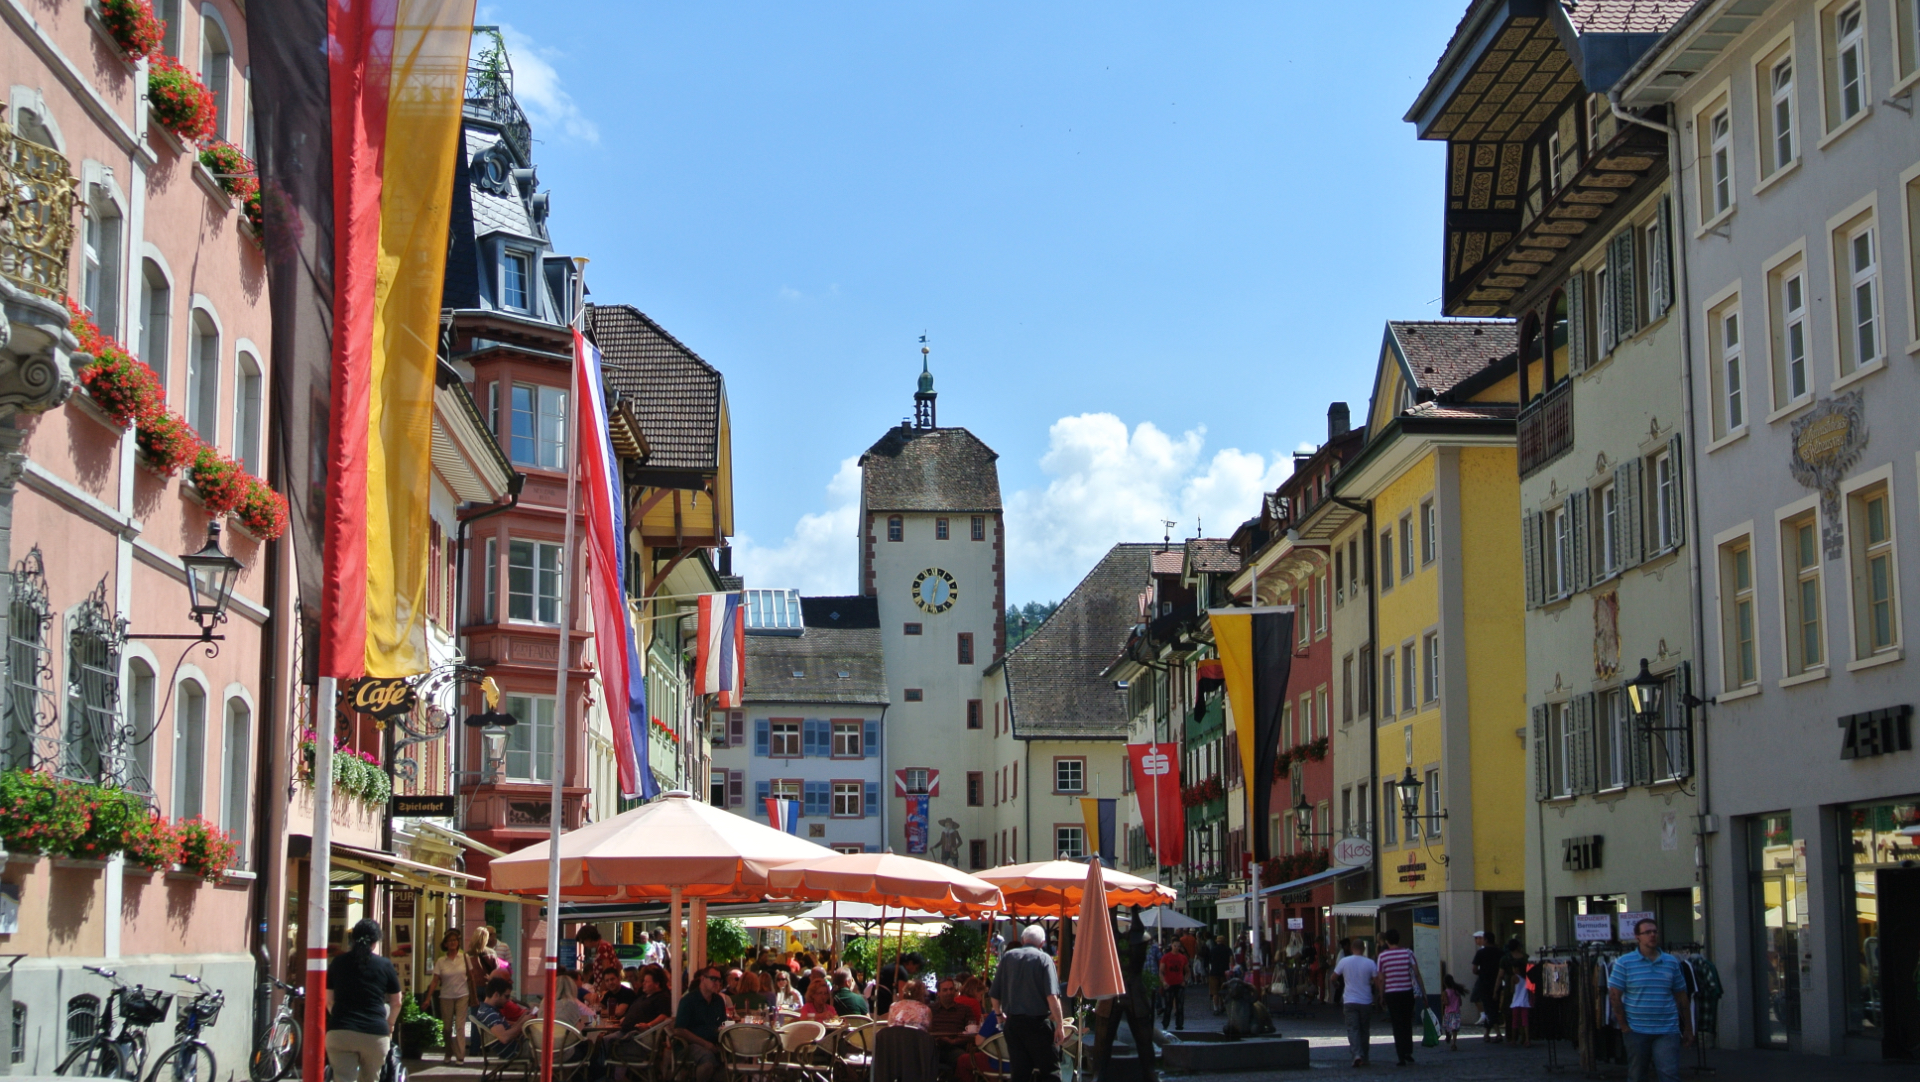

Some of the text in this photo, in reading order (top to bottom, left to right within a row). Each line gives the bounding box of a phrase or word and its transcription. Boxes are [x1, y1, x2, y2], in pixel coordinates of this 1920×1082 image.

[1837, 704, 1912, 760] ZETT
[398, 802, 444, 812] Spielothek
[1561, 834, 1603, 871] ZETT
[394, 891, 414, 901] PUR
